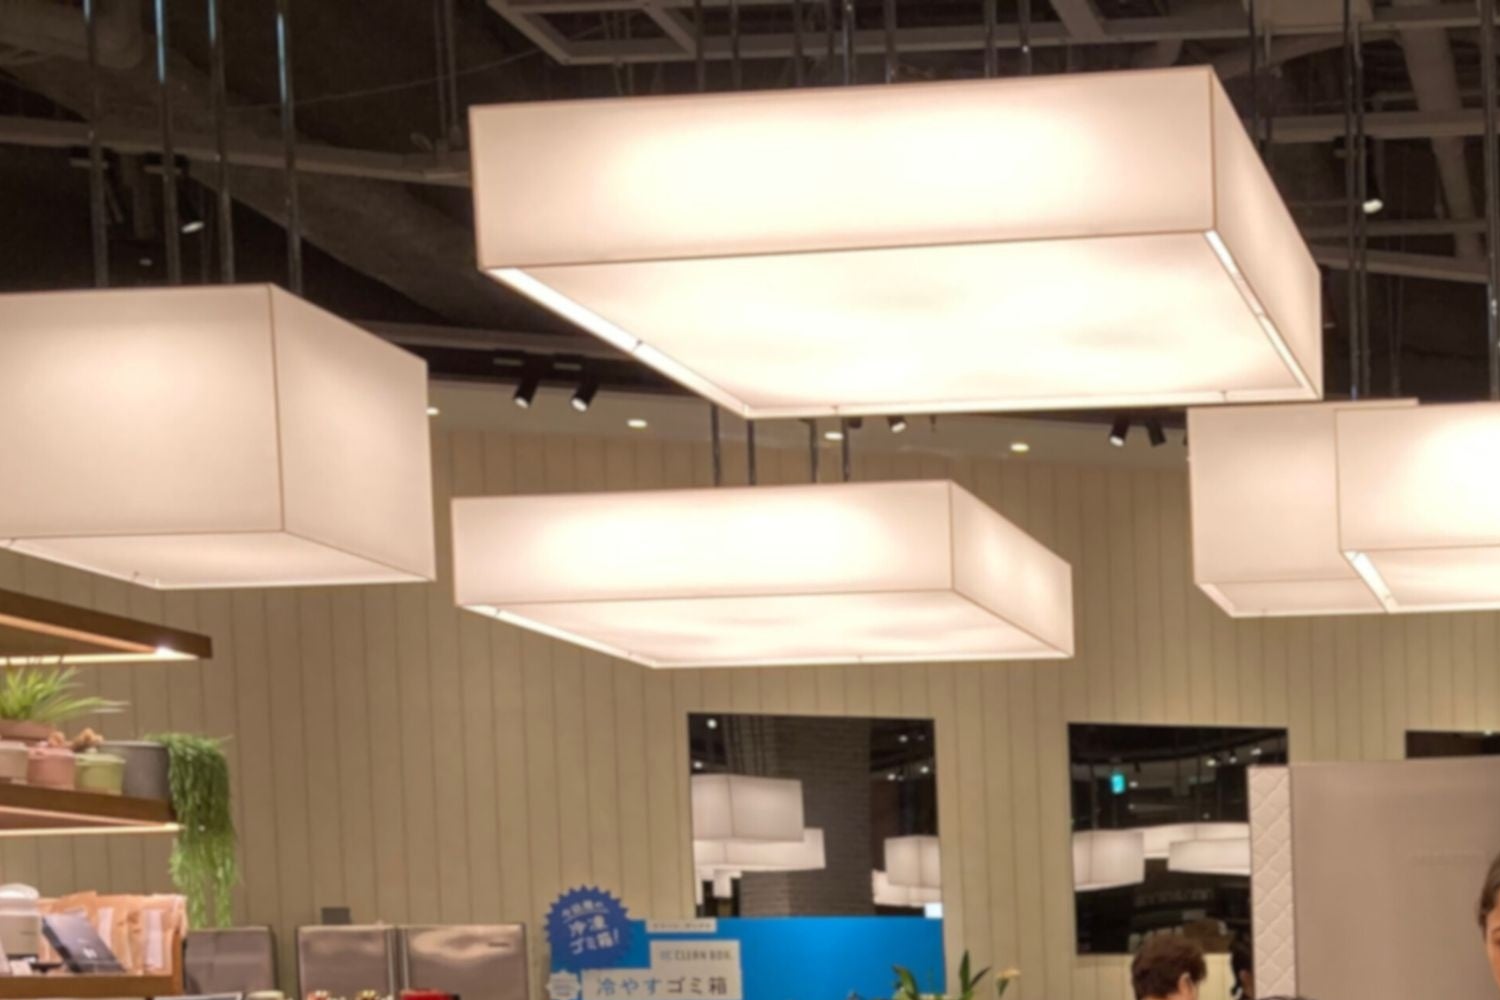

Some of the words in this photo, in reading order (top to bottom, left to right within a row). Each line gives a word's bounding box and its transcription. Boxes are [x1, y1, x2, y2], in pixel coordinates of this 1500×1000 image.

[597, 976, 728, 996] 冷やすゴミ箱
